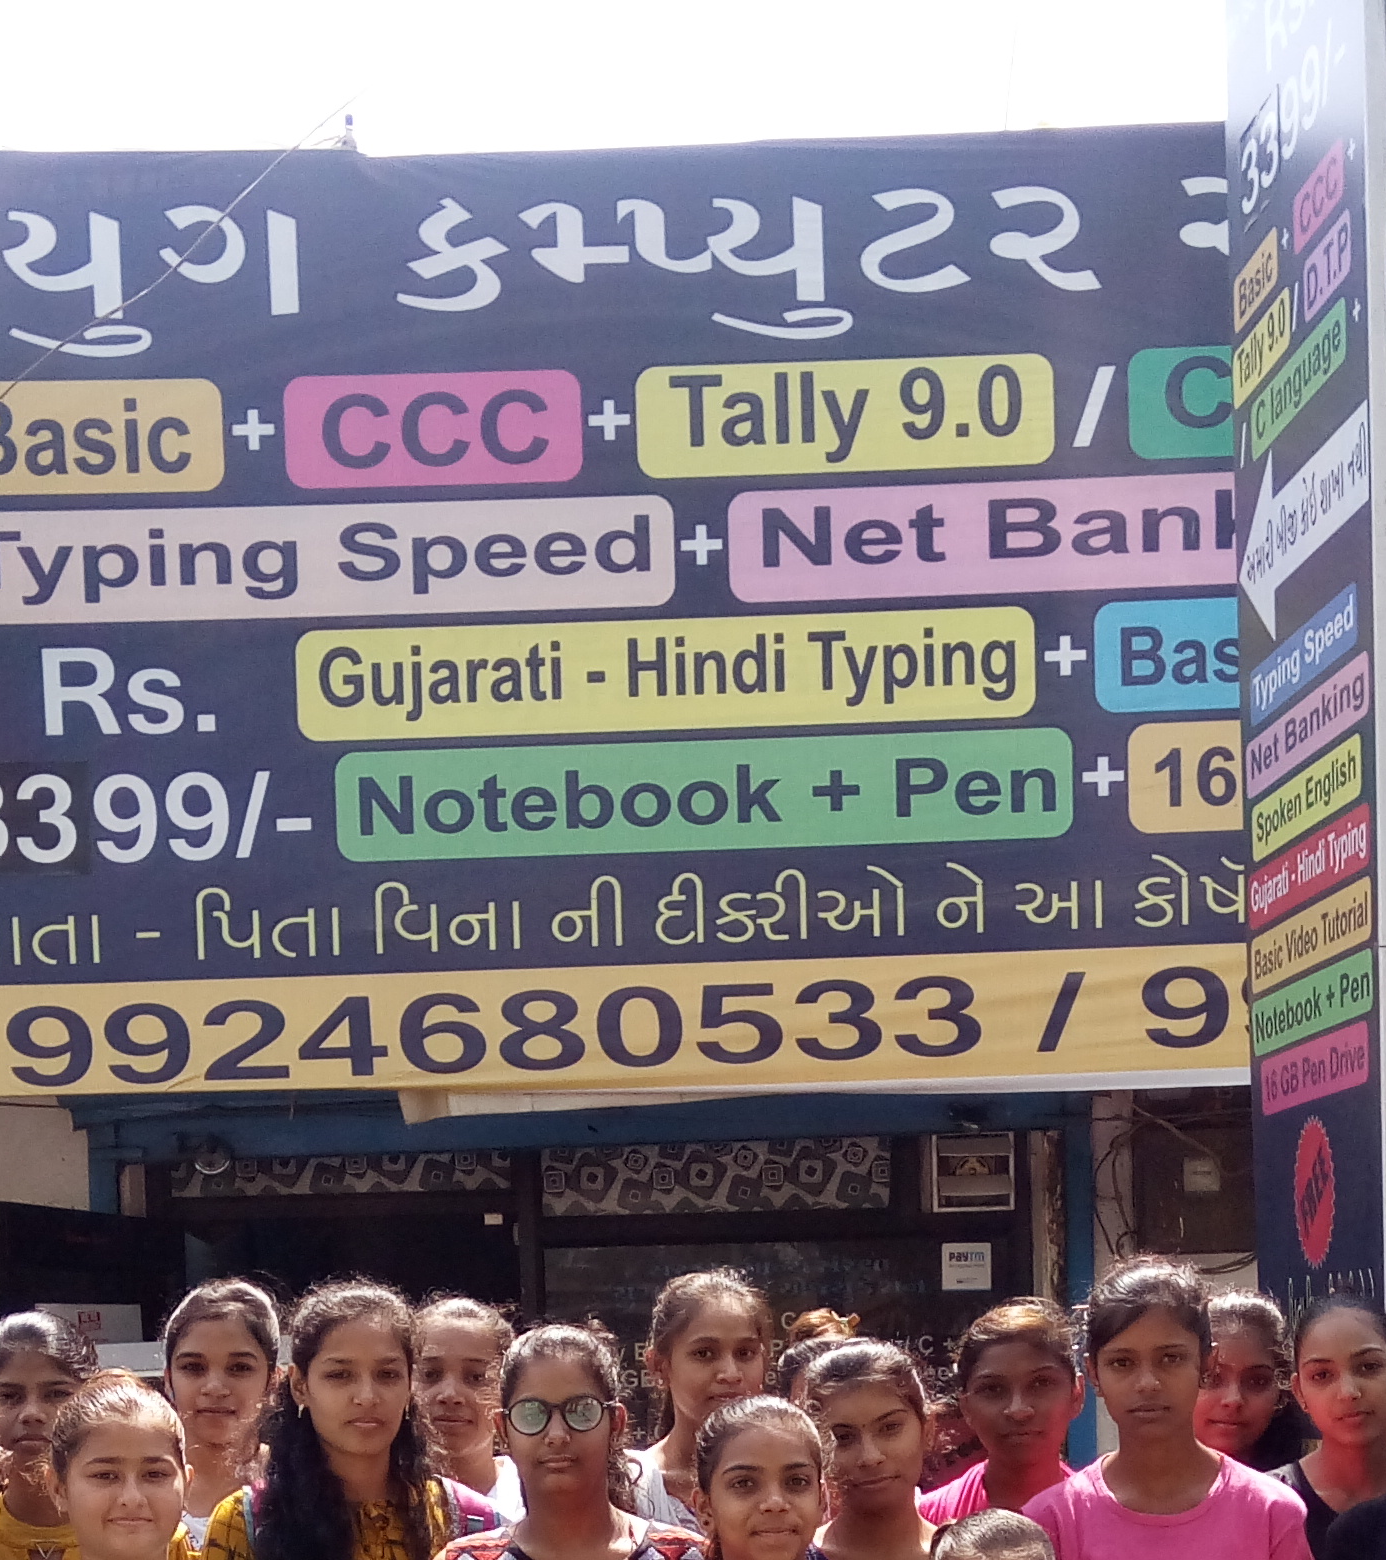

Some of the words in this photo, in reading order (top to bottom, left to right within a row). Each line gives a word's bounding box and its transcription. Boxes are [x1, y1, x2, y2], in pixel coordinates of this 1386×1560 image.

[1299, 155, 1338, 234] CCC
[1, 204, 301, 358] યુગ
[1237, 332, 1265, 388] Tally
[1267, 309, 1287, 360] 9.0
[1307, 227, 1349, 311] D.T.P
[1239, 250, 1274, 318] Basic
[321, 389, 550, 470] CCC
[668, 369, 870, 464] Tally
[898, 363, 1023, 442] 9.0
[1268, 317, 1342, 425] language
[337, 512, 652, 595] Speed
[760, 498, 947, 569] Net
[41, 645, 217, 738] Rs.
[318, 641, 564, 722] Gujarati
[626, 631, 786, 699] Hindi
[808, 627, 1017, 708] Typing
[1120, 624, 1241, 688] Bas
[1252, 653, 1301, 711] Typing
[1304, 594, 1355, 664] Speed
[1250, 733, 1281, 780] Net
[1285, 671, 1366, 751] Banking
[358, 761, 782, 837] Notebook
[894, 755, 1058, 819] Pen
[1154, 743, 1237, 809] 16
[1256, 789, 1302, 843] Spoken
[1305, 752, 1357, 811] English
[195, 886, 341, 961] પિતા
[374, 880, 521, 955] વિના
[551, 875, 623, 949] ની
[654, 865, 905, 945] દીકરીઓ
[937, 861, 985, 934] ને
[1015, 879, 1104, 930] આ
[1251, 862, 1289, 914] Gujarati
[1297, 845, 1326, 888] Hindi
[1327, 827, 1368, 871] Typing
[1254, 946, 1283, 980] Basic
[1285, 926, 1318, 961] Video
[1320, 895, 1369, 948] Tutorial
[5, 973, 984, 1088] 9924680533
[1255, 987, 1323, 1046] Notebook
[1340, 970, 1370, 1006] Pen
[1329, 1043, 1366, 1081] Drive
